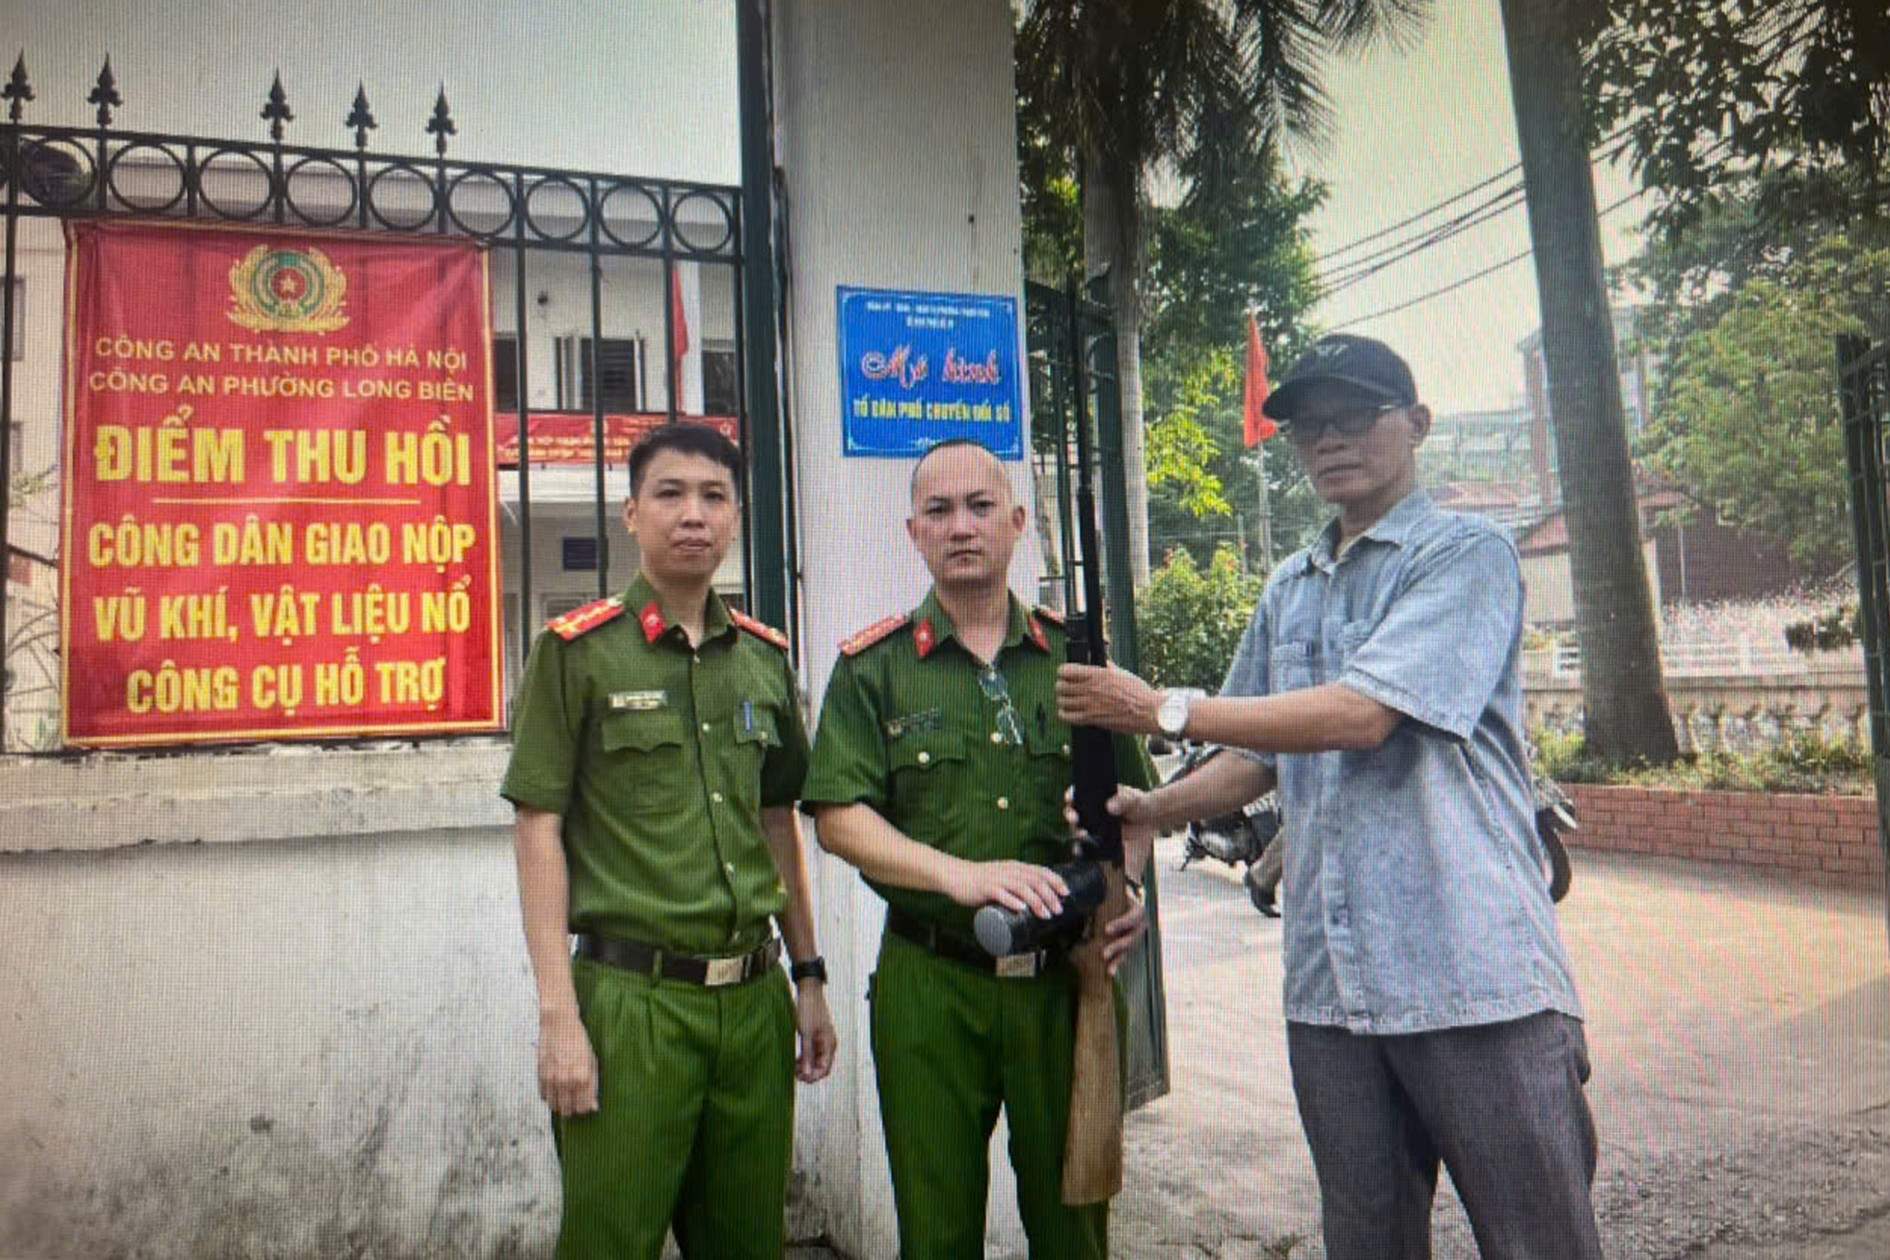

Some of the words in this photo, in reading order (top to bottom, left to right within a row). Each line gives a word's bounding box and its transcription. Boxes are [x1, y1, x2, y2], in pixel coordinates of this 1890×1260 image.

[89, 366, 168, 394] CÔNG
[179, 374, 215, 395] AN
[223, 371, 334, 398] PHƯỜNG
[343, 379, 411, 399] LONG
[419, 376, 474, 402] BIÊN
[95, 333, 175, 361] CÔNG
[184, 341, 220, 362] AN
[230, 339, 317, 366] THÀNH
[326, 341, 379, 367] PHỐ
[386, 343, 419, 368] HÀ
[427, 347, 467, 373] NỘI
[93, 403, 245, 484] ĐIỂM
[264, 428, 366, 484] THU
[386, 413, 471, 486] HỒI
[88, 513, 200, 568] CÔNG
[212, 513, 293, 565] DÂN
[305, 522, 390, 565] GIAO
[402, 515, 476, 574] NỘP
[93, 587, 147, 642] VŨ
[159, 585, 239, 643] KHÍ,
[250, 584, 321, 646] VẬT
[332, 583, 409, 644] LIỆU
[421, 574, 472, 634] NỔ
[127, 658, 239, 714] CÔNG
[252, 665, 303, 716] CỤ
[315, 646, 364, 707] HỖ
[375, 656, 446, 712] TRỢ
